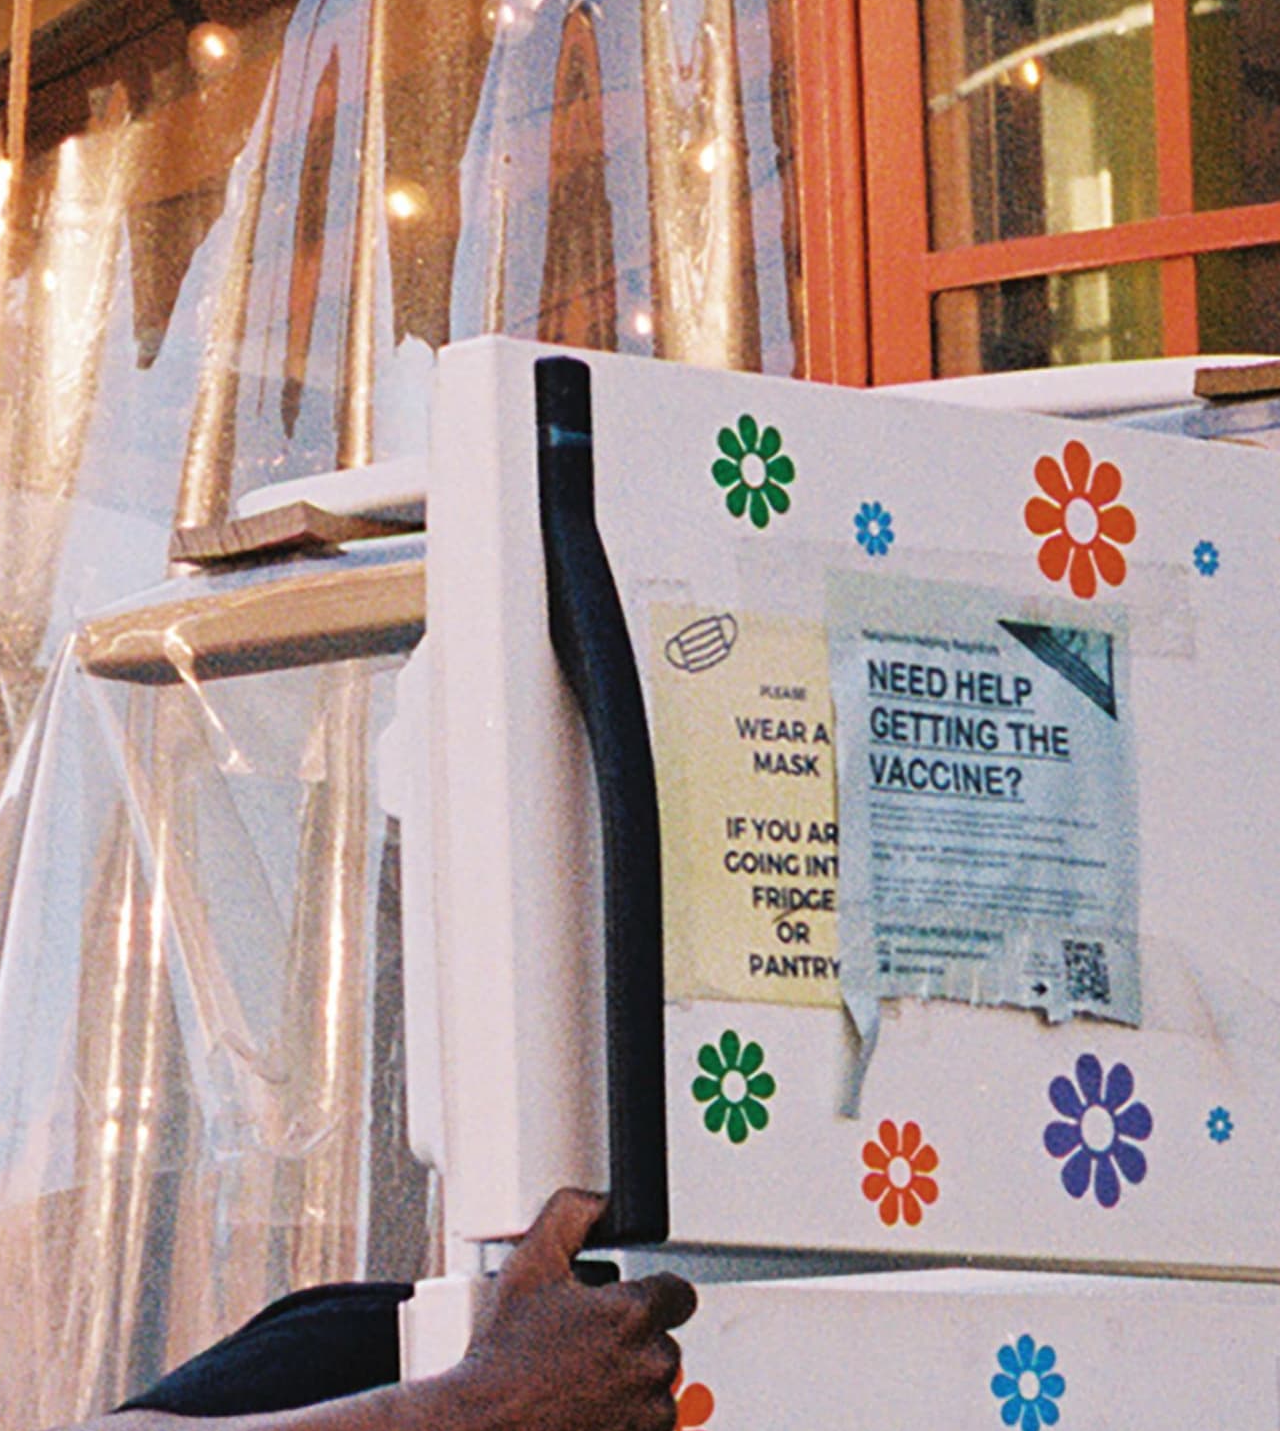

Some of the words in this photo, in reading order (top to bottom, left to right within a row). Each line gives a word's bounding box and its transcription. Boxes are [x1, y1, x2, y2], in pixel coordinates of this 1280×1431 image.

[760, 684, 807, 701] PLEASE
[868, 660, 948, 695] NEED
[957, 671, 1033, 706] HELP
[736, 717, 807, 744] WEAR
[812, 723, 831, 746] A
[870, 706, 999, 751] GETTING
[1007, 722, 1070, 756] THE
[753, 752, 820, 777] MASK
[869, 753, 1023, 797] VACCINE?
[726, 817, 747, 840] IF
[752, 819, 801, 844] YOU
[807, 822, 839, 846] AR
[724, 850, 800, 876] GOING
[805, 855, 839, 879] INT
[752, 886, 837, 912] FRIDGE
[776, 921, 811, 944] OR
[749, 953, 841, 979] PANTRY
